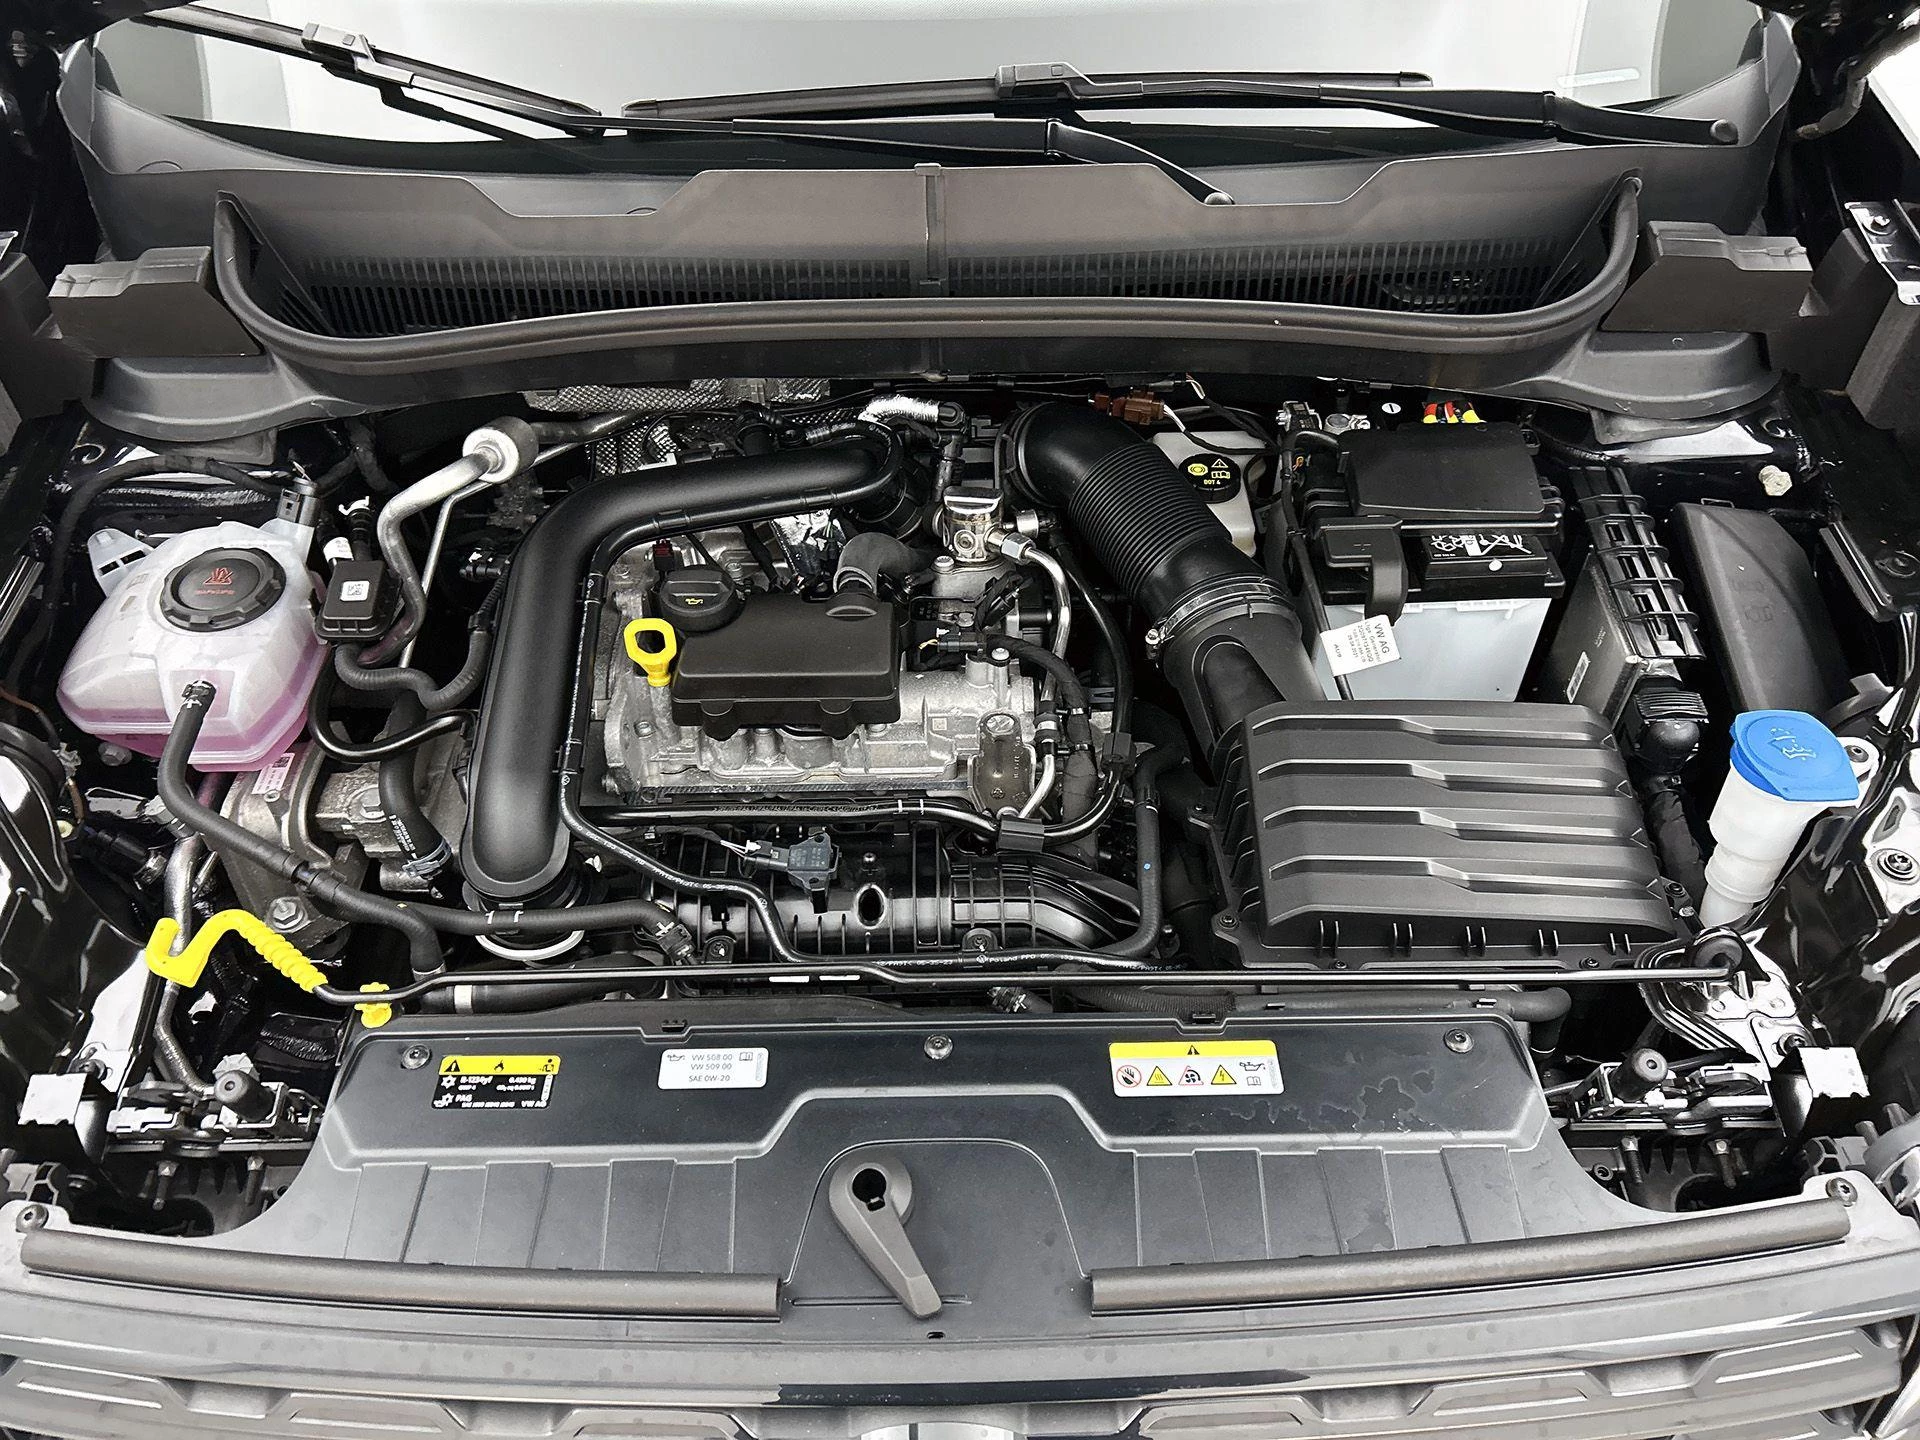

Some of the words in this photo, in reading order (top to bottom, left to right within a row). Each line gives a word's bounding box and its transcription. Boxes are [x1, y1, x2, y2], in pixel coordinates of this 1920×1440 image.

[1374, 623, 1386, 638] VW
[1379, 640, 1390, 654] AG
[704, 1074, 730, 1082] 0W-20
[454, 1093, 472, 1102] PAG
